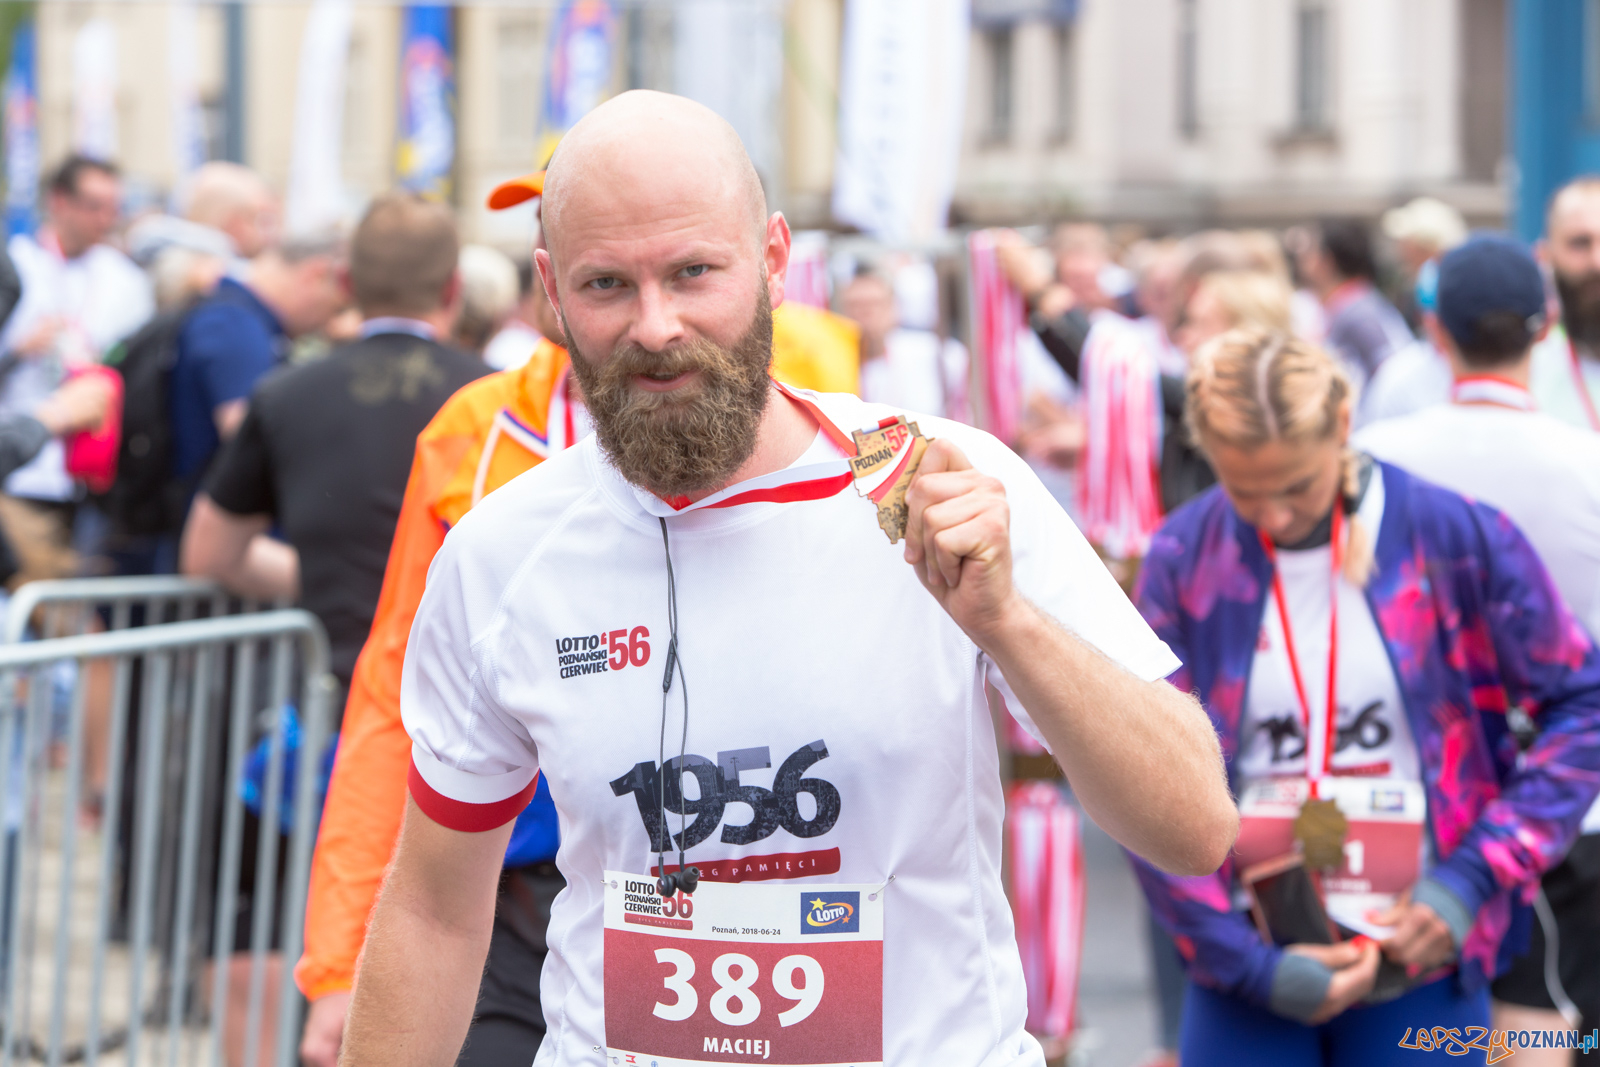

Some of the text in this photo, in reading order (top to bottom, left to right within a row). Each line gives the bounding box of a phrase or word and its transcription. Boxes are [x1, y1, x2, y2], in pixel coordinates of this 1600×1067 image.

[854, 445, 892, 471] POZNAŃ
[555, 634, 600, 654] LOTTO
[558, 649, 607, 667] POZNAŃSKI
[560, 660, 608, 679] CZERWIEC
[609, 739, 841, 853] 1956
[732, 858, 816, 876] PAMIĘCI
[624, 880, 655, 896] LOTTO
[624, 893, 661, 906] POZNAŃSKI
[624, 902, 662, 916] CZERWIEC
[816, 906, 845, 923] LOTTO
[711, 925, 781, 936] Poznań, 2018-06-24
[652, 947, 825, 1028] 389
[703, 1037, 771, 1060] MACIEJ
